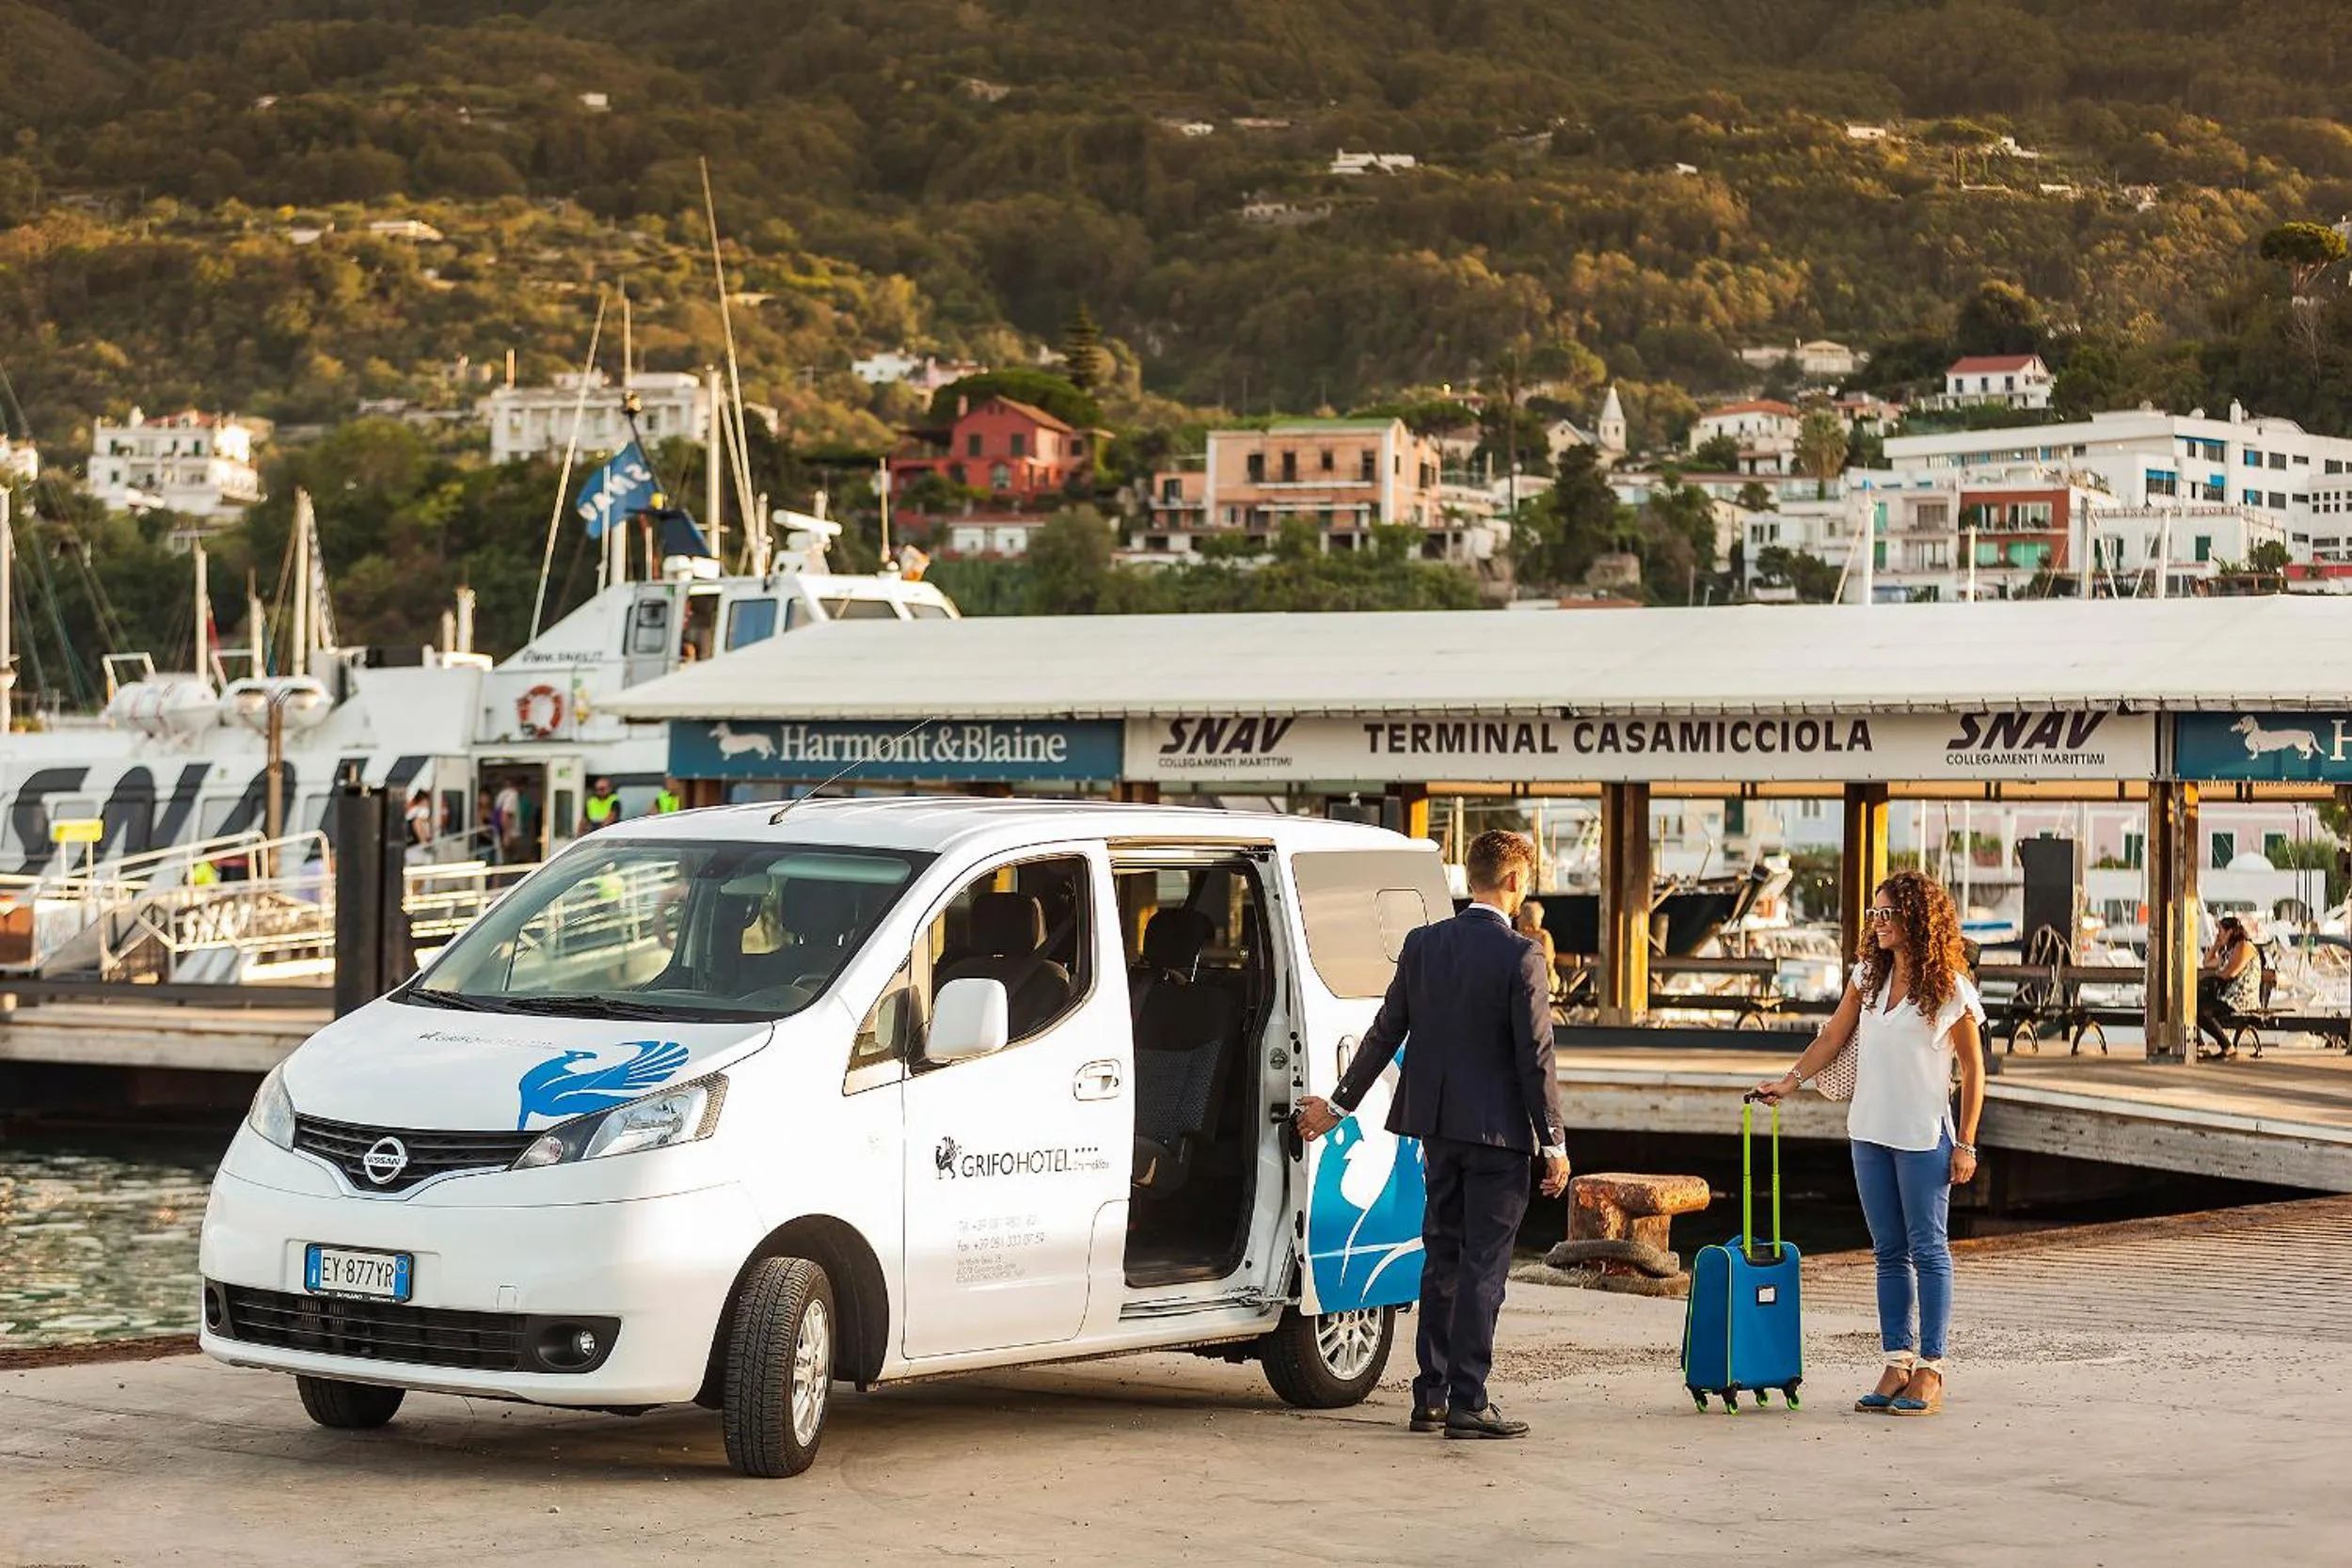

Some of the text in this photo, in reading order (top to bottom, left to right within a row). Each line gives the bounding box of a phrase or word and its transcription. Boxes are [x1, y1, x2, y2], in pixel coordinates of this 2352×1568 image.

[1159, 717, 1297, 753] SNAV
[1363, 720, 1874, 752] TERMINAL CASAMICCIOLA
[1946, 711, 2108, 750] SNAV
[1158, 756, 1292, 768] COLLEGAMENTI MARITTIMI
[1947, 753, 2106, 766] COLLEGAMENTI MARITTIMI
